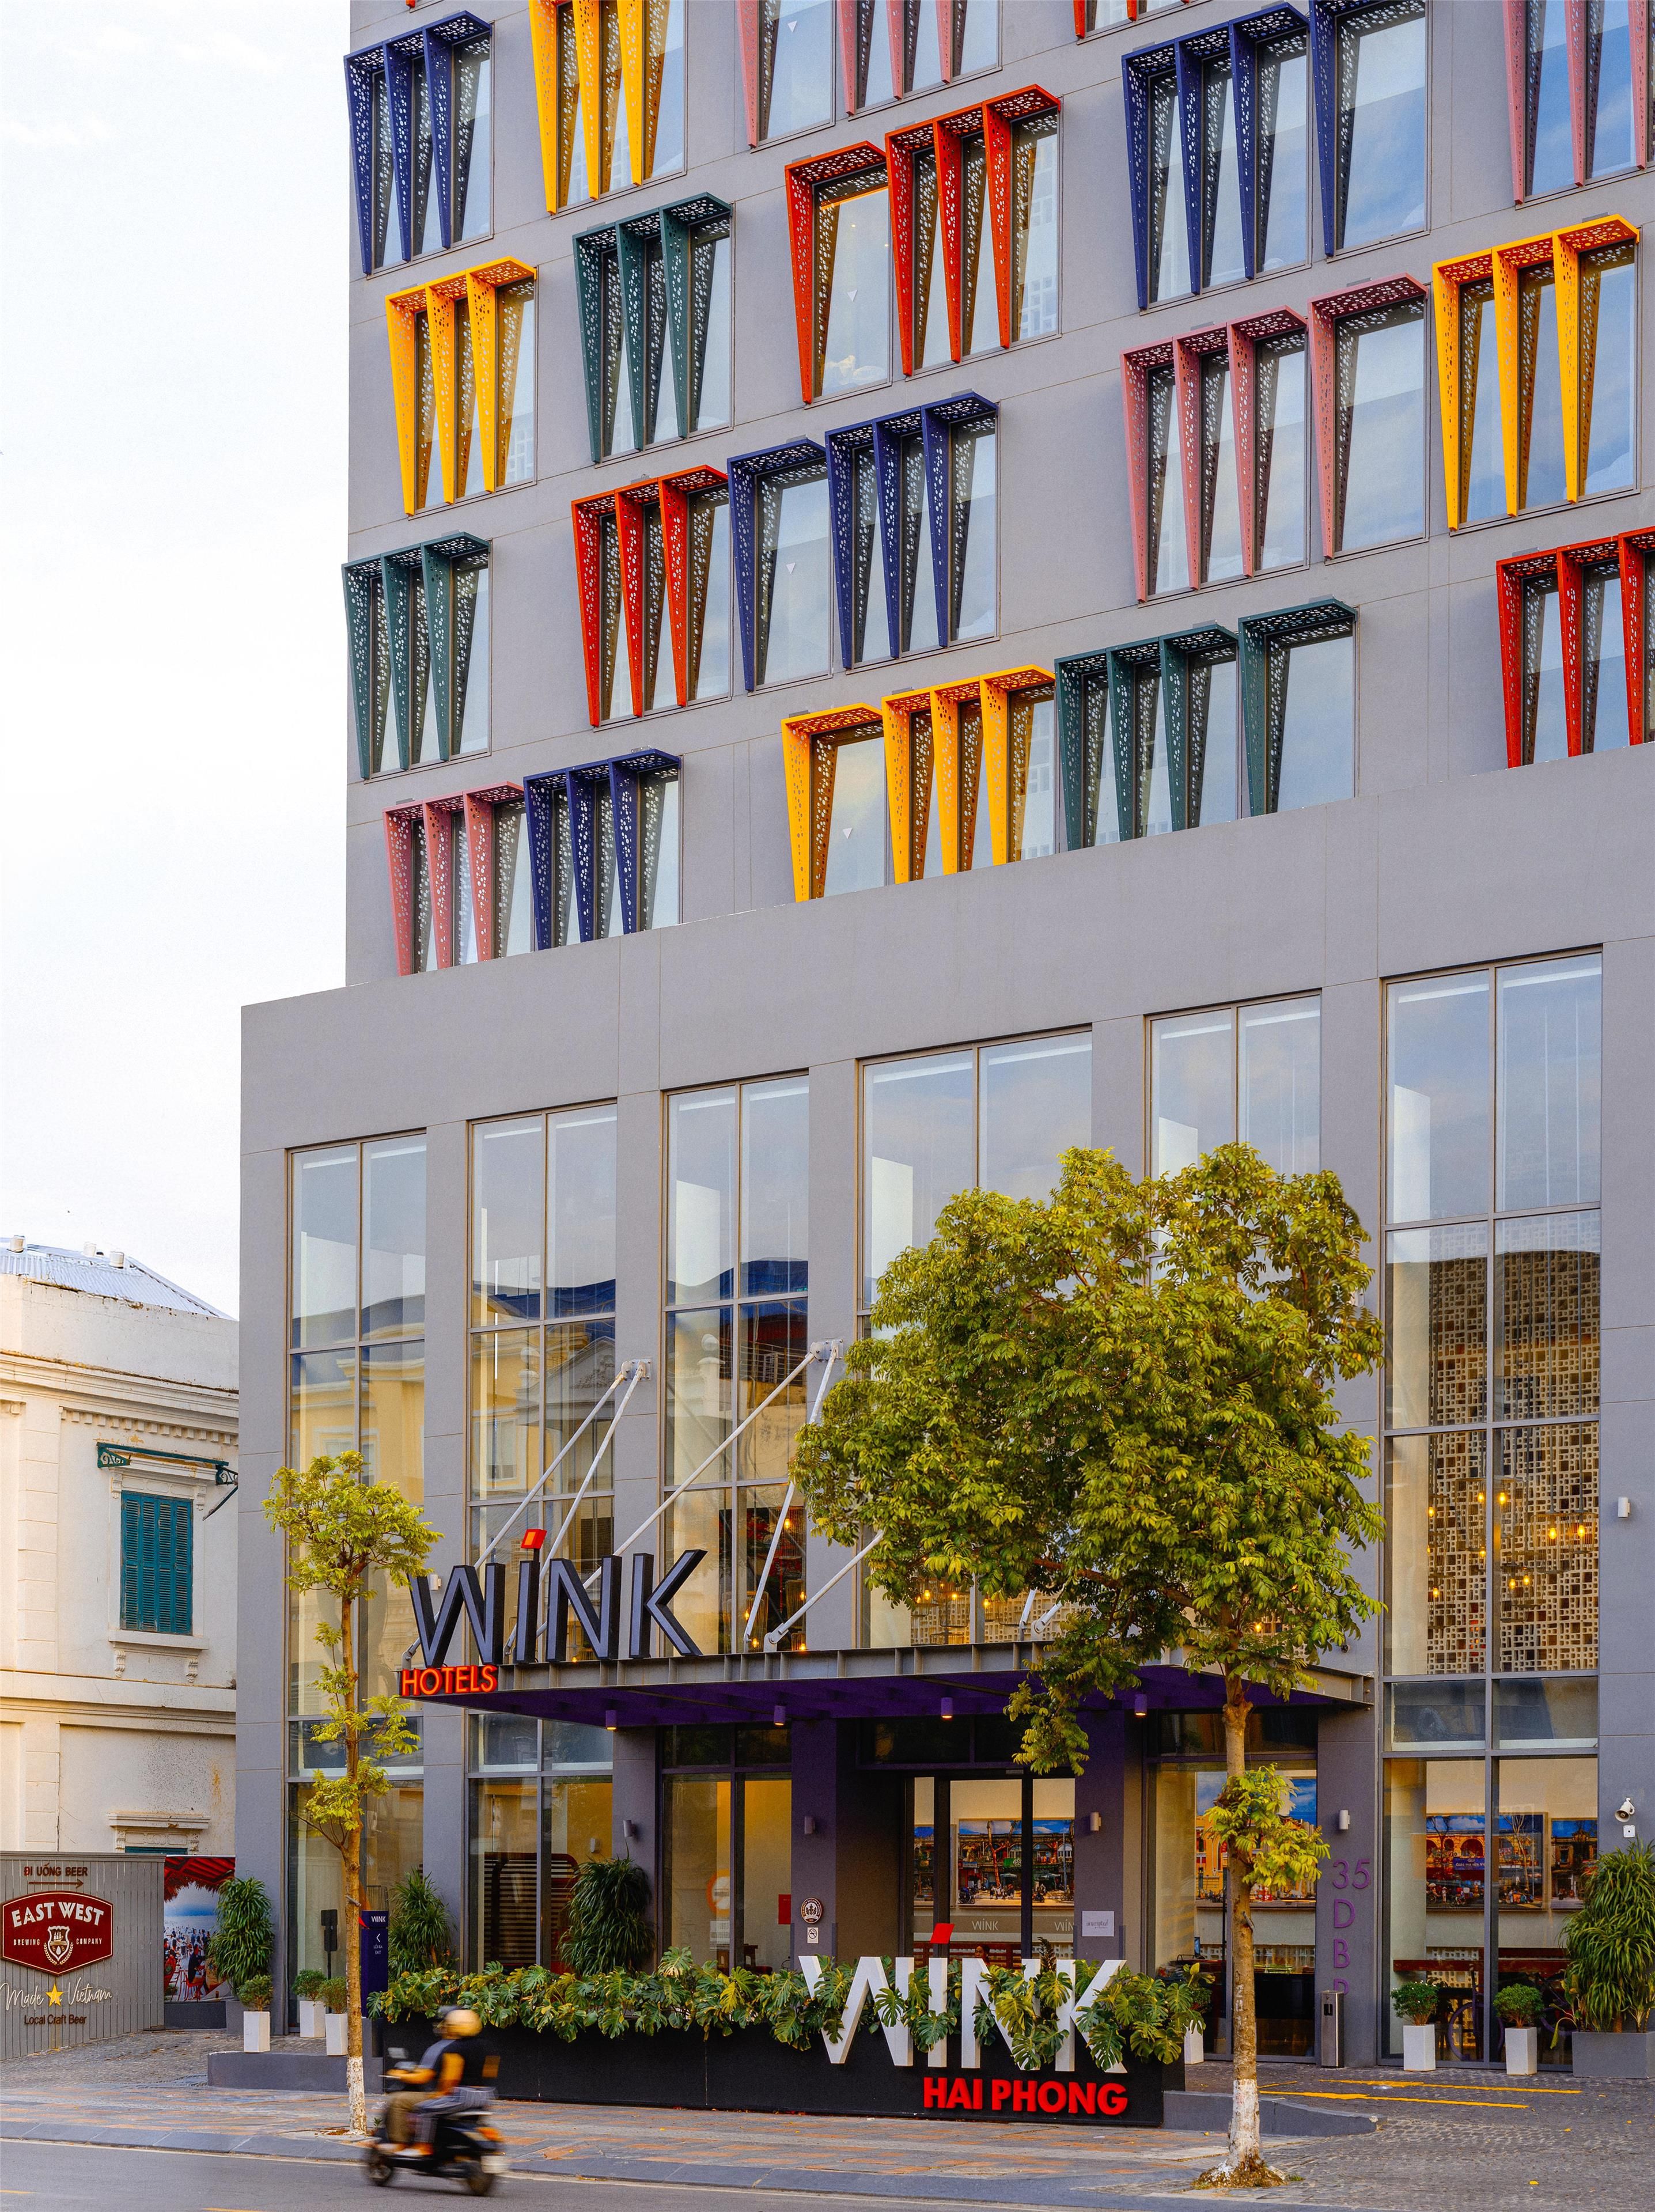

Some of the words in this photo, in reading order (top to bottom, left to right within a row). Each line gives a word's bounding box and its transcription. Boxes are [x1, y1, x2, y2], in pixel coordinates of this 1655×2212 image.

[407, 1528, 708, 1668] WINK
[402, 1664, 498, 1696] HOTELS
[24, 1866, 33, 1876] ĐI
[36, 1863, 62, 1876] UỐNG
[65, 1866, 88, 1876] BEER
[1332, 1858, 1370, 1889] 35
[11, 1902, 55, 1927] EAST
[58, 1902, 104, 1926] WEST
[972, 1918, 998, 1931] WINK
[1054, 1919, 1074, 1931] WIN
[1334, 1899, 1355, 1928] D
[1334, 1938, 1350, 1968] B
[0, 1982, 44, 2011] Made
[67, 1976, 112, 2006] Vietnam
[24, 2014, 45, 2025] Local
[47, 2014, 66, 2025] Craft
[69, 2014, 87, 2025] Beer
[923, 2077, 983, 2109] HAI
[991, 2079, 1128, 2115] PHONG
